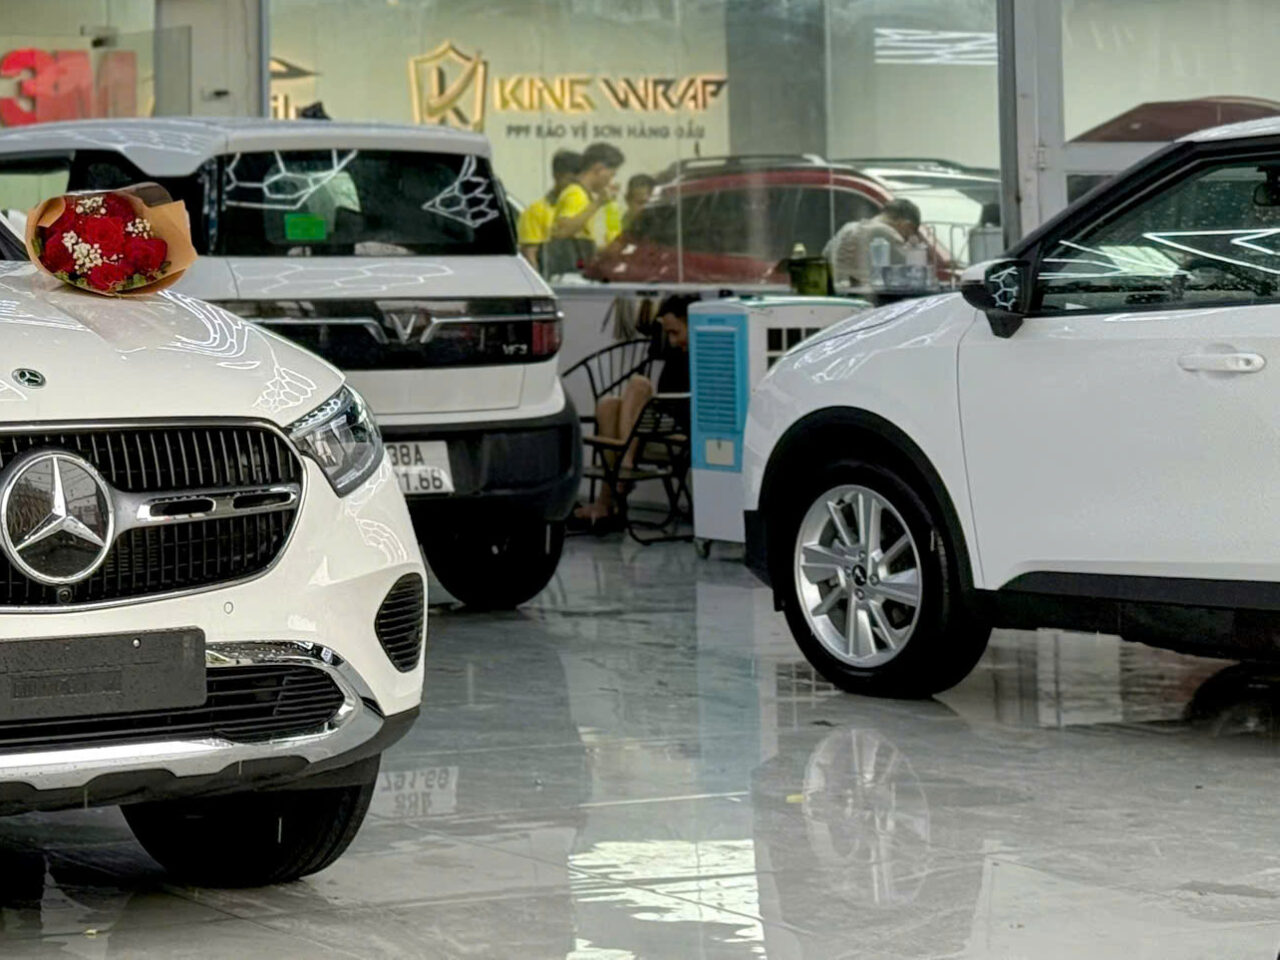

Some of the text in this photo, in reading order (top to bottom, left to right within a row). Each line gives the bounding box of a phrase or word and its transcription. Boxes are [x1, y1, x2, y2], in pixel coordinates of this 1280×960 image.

[494, 77, 728, 112] KING WRAP
[386, 443, 425, 467] 38A
[396, 470, 444, 492] 1.66
